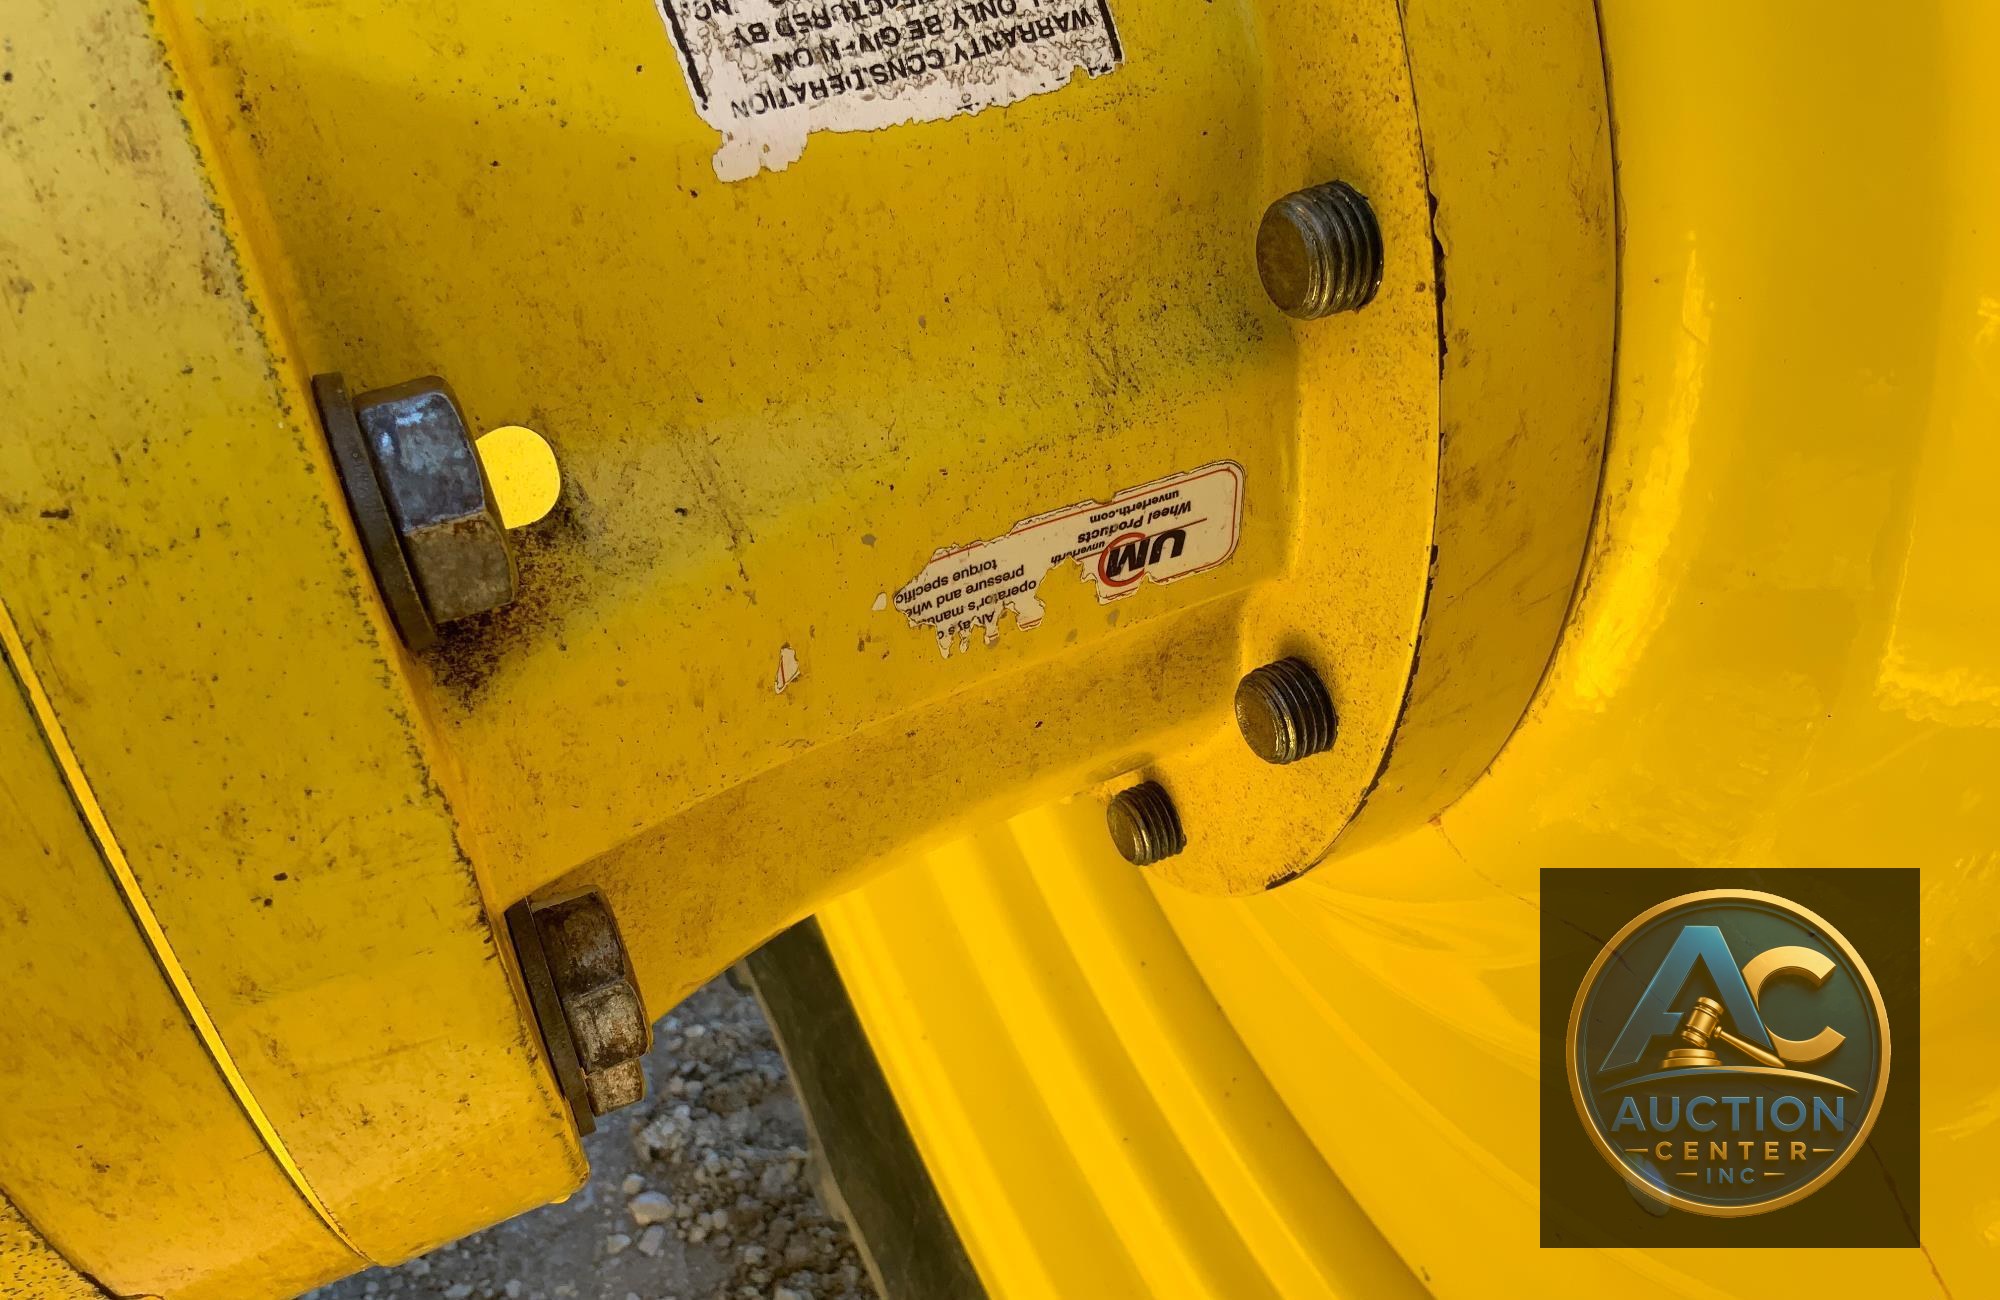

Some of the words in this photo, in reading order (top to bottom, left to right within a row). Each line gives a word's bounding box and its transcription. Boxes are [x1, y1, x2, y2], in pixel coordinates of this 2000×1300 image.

[906, 14, 945, 41] BE
[952, 0, 1017, 30] ONLY
[734, 22, 769, 47] BY
[954, 7, 1095, 65] WARRANTY
[772, 48, 815, 75] ON
[1089, 490, 1180, 524] unverferth.com
[1148, 501, 1191, 525] Wheel
[1078, 515, 1144, 544] Products
[1106, 529, 1187, 578] UM
[953, 559, 997, 582] torque
[966, 564, 1024, 594] pressure
[895, 576, 949, 605] specific
[936, 591, 962, 608] and
[968, 580, 1037, 611] operator's
